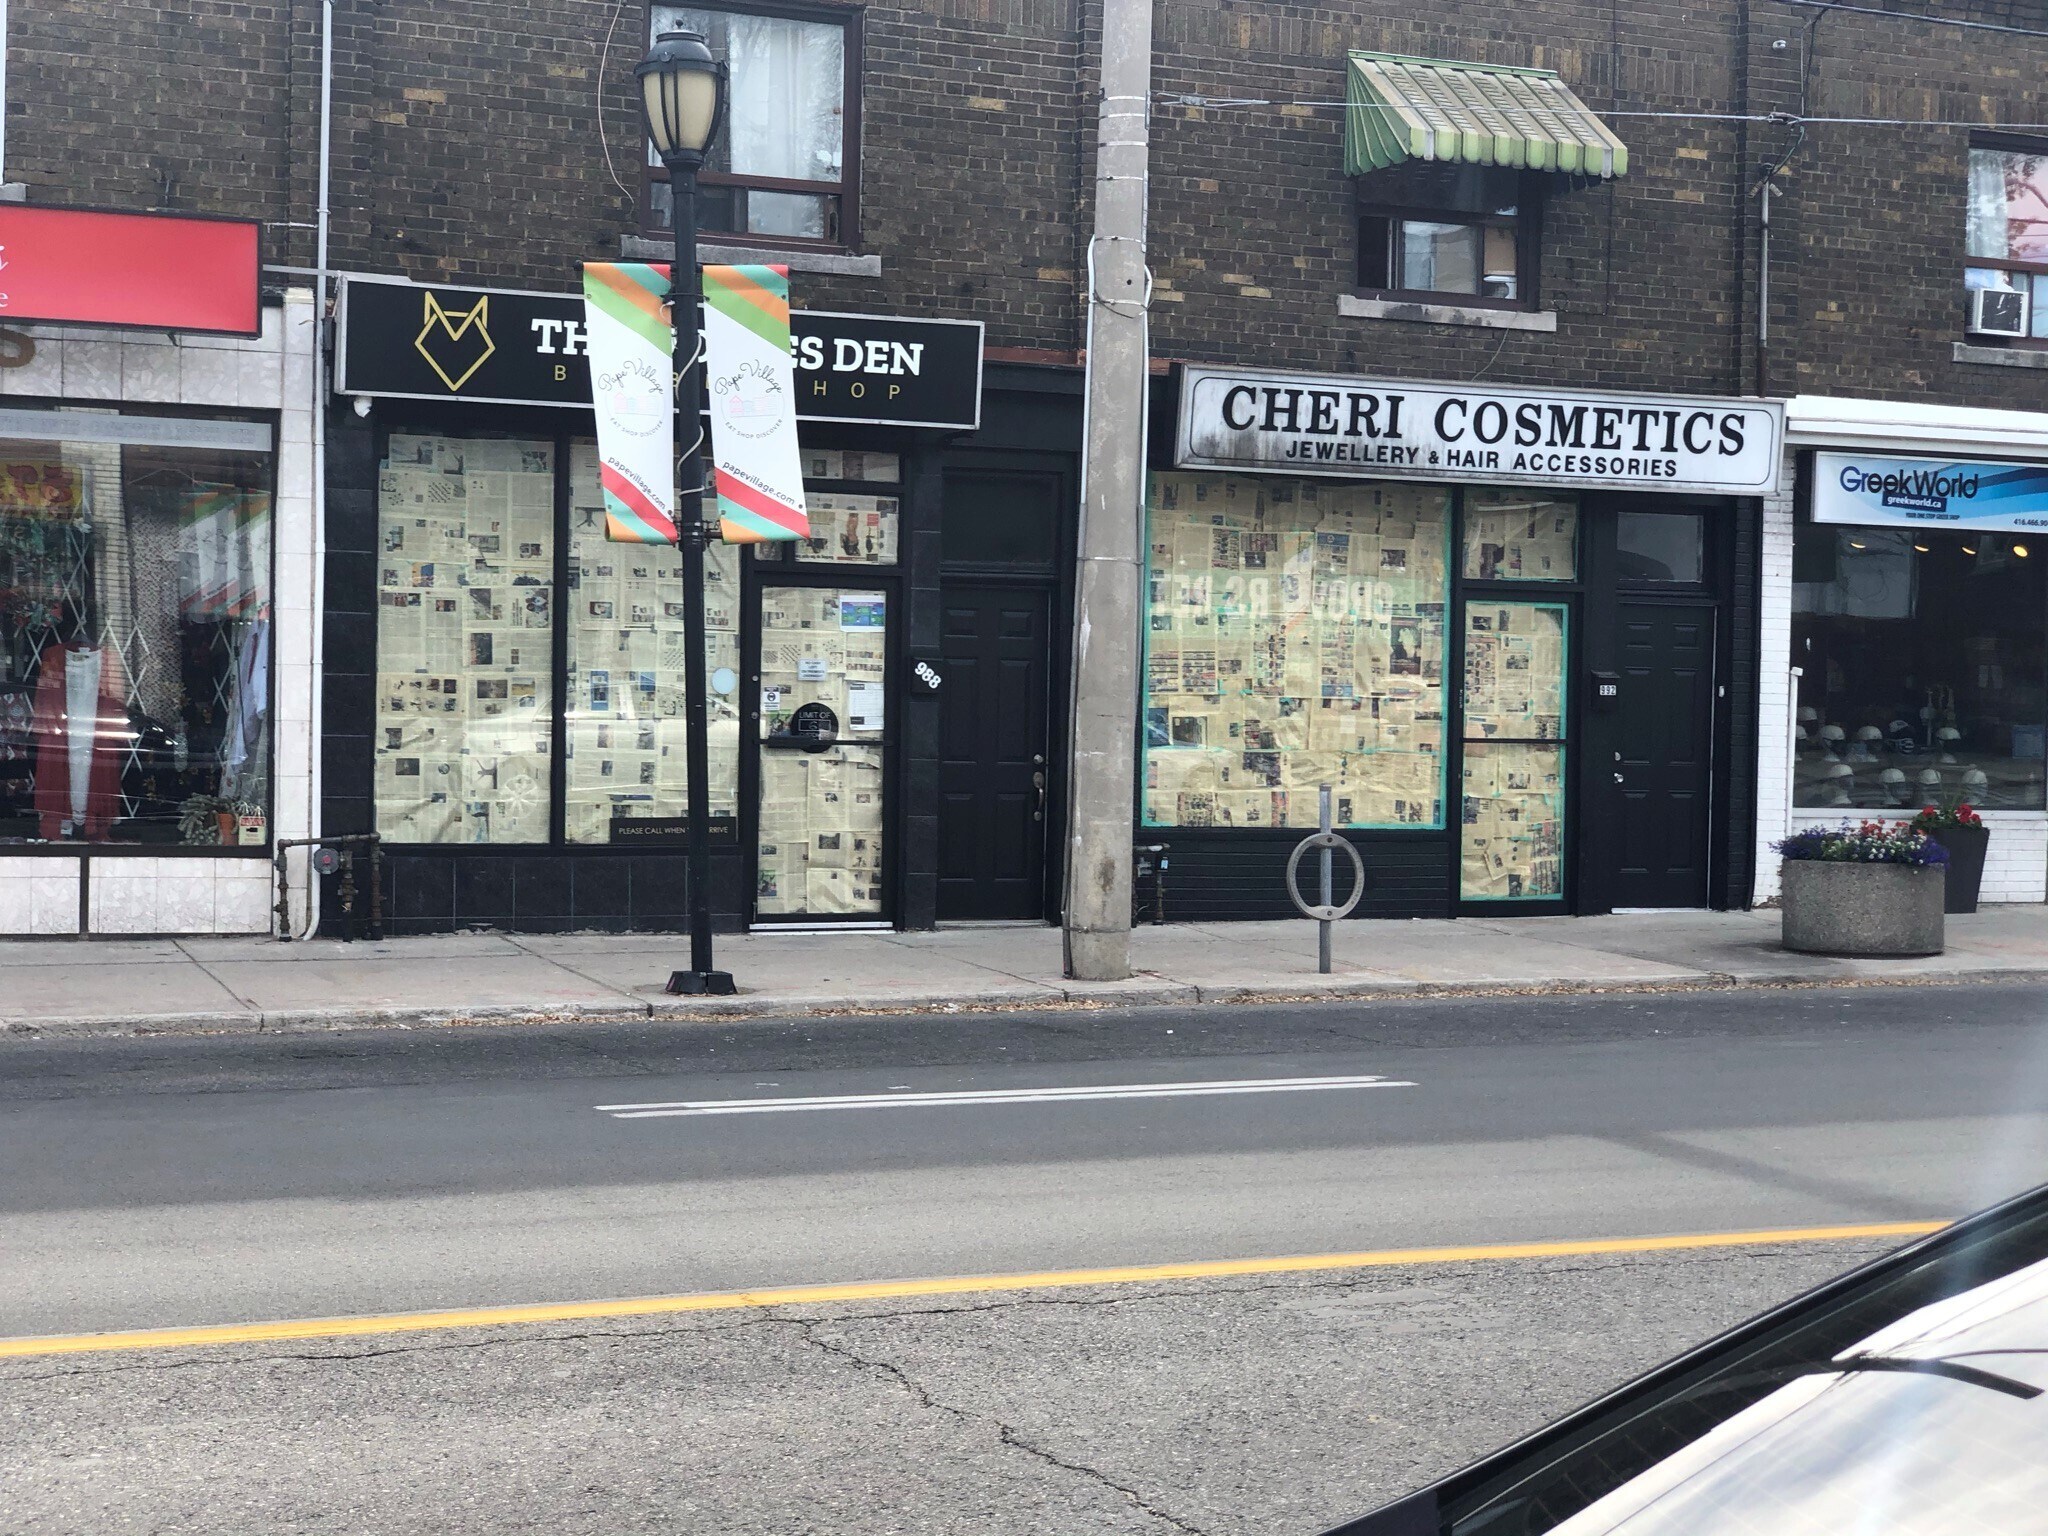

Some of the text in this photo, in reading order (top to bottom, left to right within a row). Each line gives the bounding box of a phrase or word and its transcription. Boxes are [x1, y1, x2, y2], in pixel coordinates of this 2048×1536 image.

[530, 318, 590, 356] TH
[832, 337, 925, 376] DEN
[598, 370, 628, 392] Pape
[622, 357, 664, 395] Village
[714, 373, 744, 396] Pape
[739, 358, 782, 394] Village
[813, 379, 901, 400] HOP
[725, 418, 783, 439] EAT SHOP DISCOVER
[1222, 385, 1746, 457] CHERI COSMETICS
[1286, 440, 1677, 477] JEWELLERY & HAIR ACCESSORIES
[608, 456, 666, 510] papevillage.com
[722, 461, 796, 505] papevillage.com
[1839, 466, 1979, 499] GreekWorld
[1887, 495, 1942, 509] greekworld.ca
[914, 661, 942, 689] 988
[1600, 685, 1616, 695] 992
[799, 711, 831, 719] LIMIT OF
[618, 826, 729, 835] PLEASE CALL WHEN RRIVE
